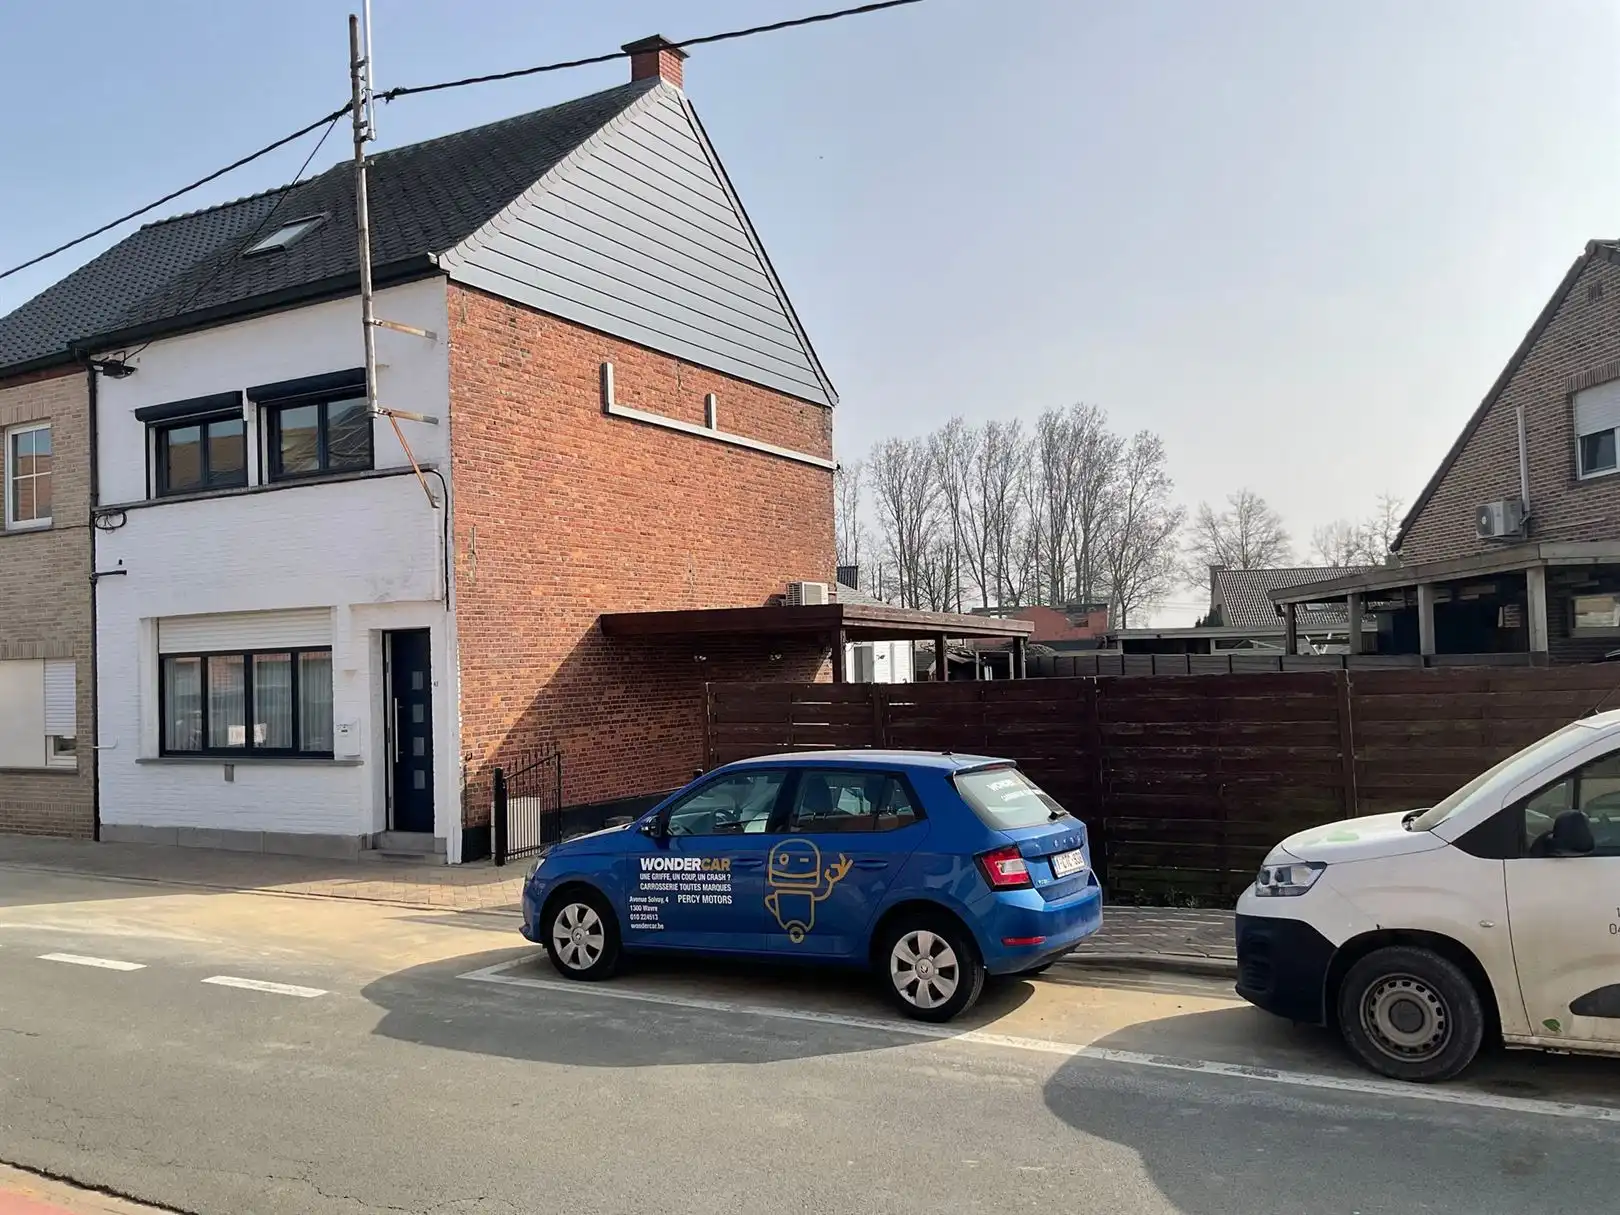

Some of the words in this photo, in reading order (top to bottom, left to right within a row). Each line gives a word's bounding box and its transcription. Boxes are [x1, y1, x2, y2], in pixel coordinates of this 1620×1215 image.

[640, 858, 730, 871] WONDERCAR
[640, 883, 678, 891] CARROSSERIE
[703, 884, 732, 892] MARQUES
[678, 894, 701, 904] PERCY
[702, 895, 732, 904] MOTORS
